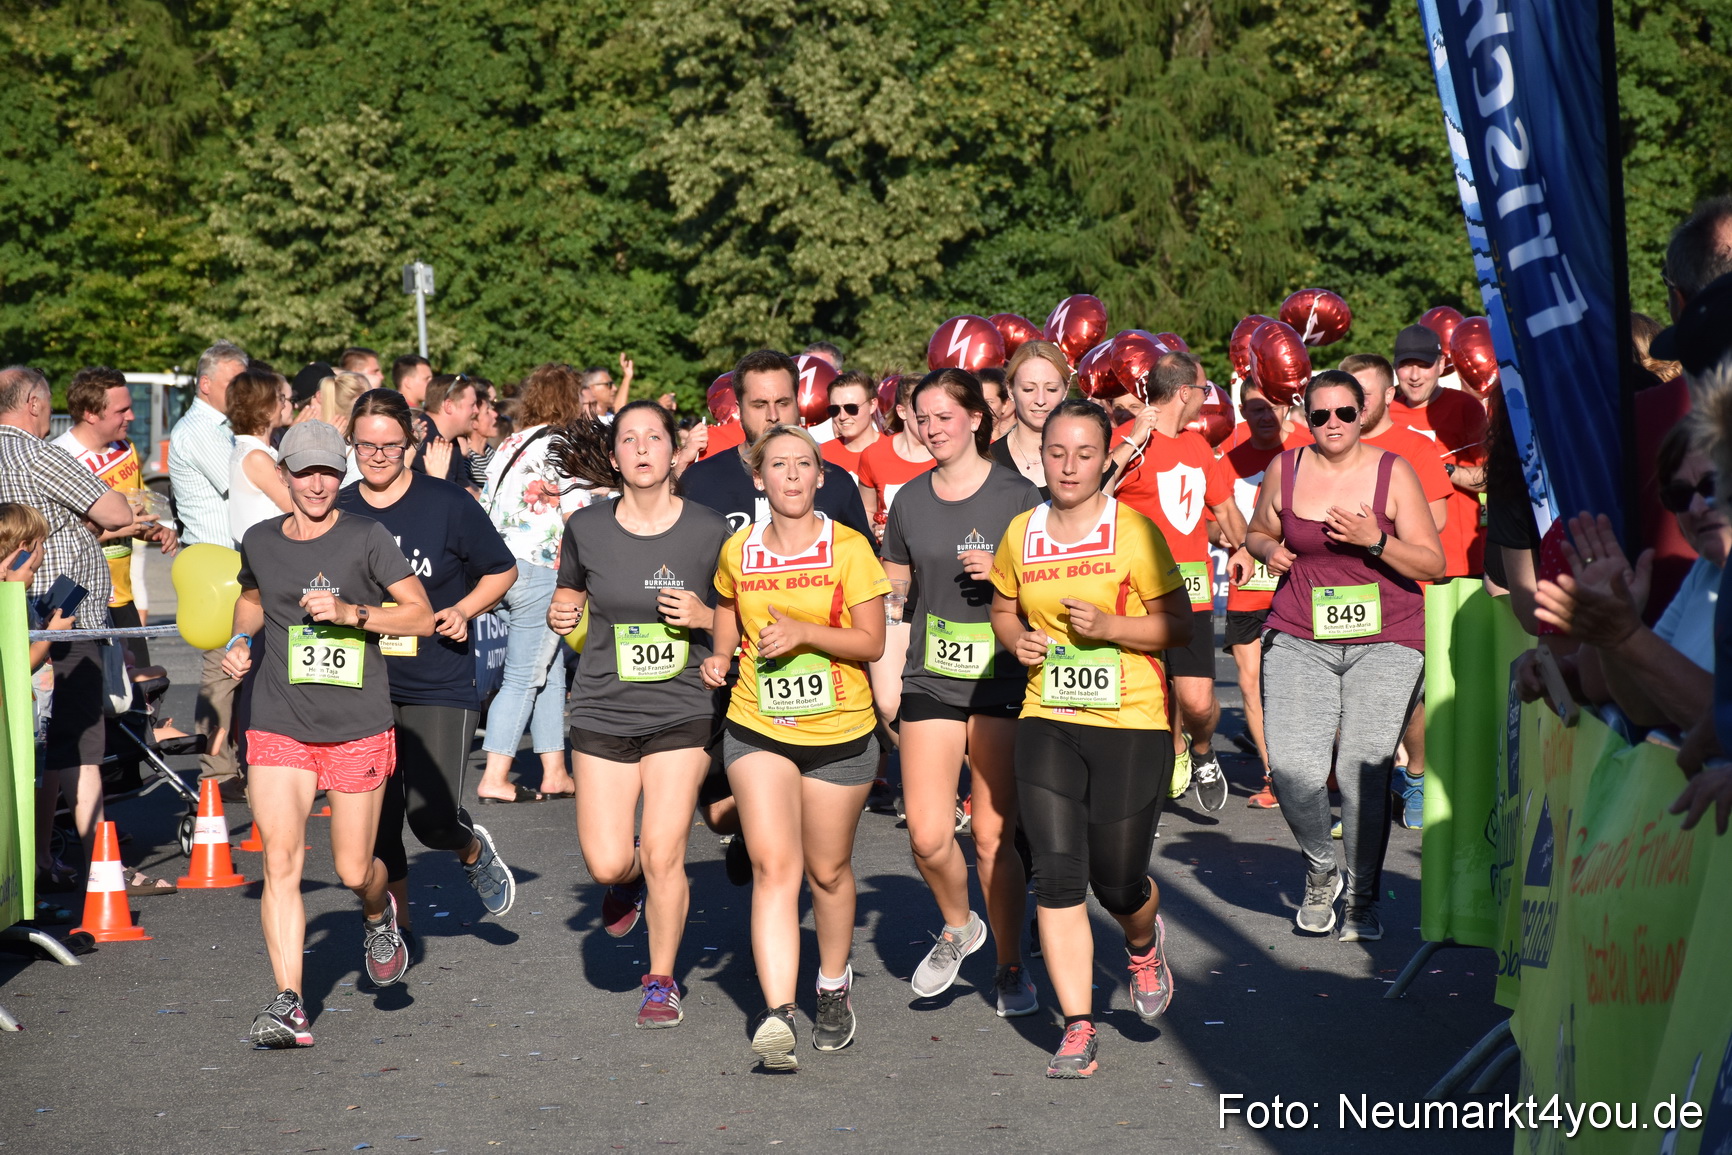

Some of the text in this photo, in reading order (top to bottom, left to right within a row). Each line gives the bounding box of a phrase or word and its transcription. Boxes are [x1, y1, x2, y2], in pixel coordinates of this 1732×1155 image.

[741, 573, 834, 593] MAX BÖGL
[1022, 561, 1116, 585] MAX BÖGL
[1327, 604, 1366, 624] 849
[302, 646, 346, 669] 326
[632, 643, 674, 665] 304
[937, 639, 973, 663] 321
[934, 658, 953, 667] Lederer
[764, 674, 823, 699] 1319
[1051, 666, 1109, 690] 1306
[795, 697, 817, 705] Robert
